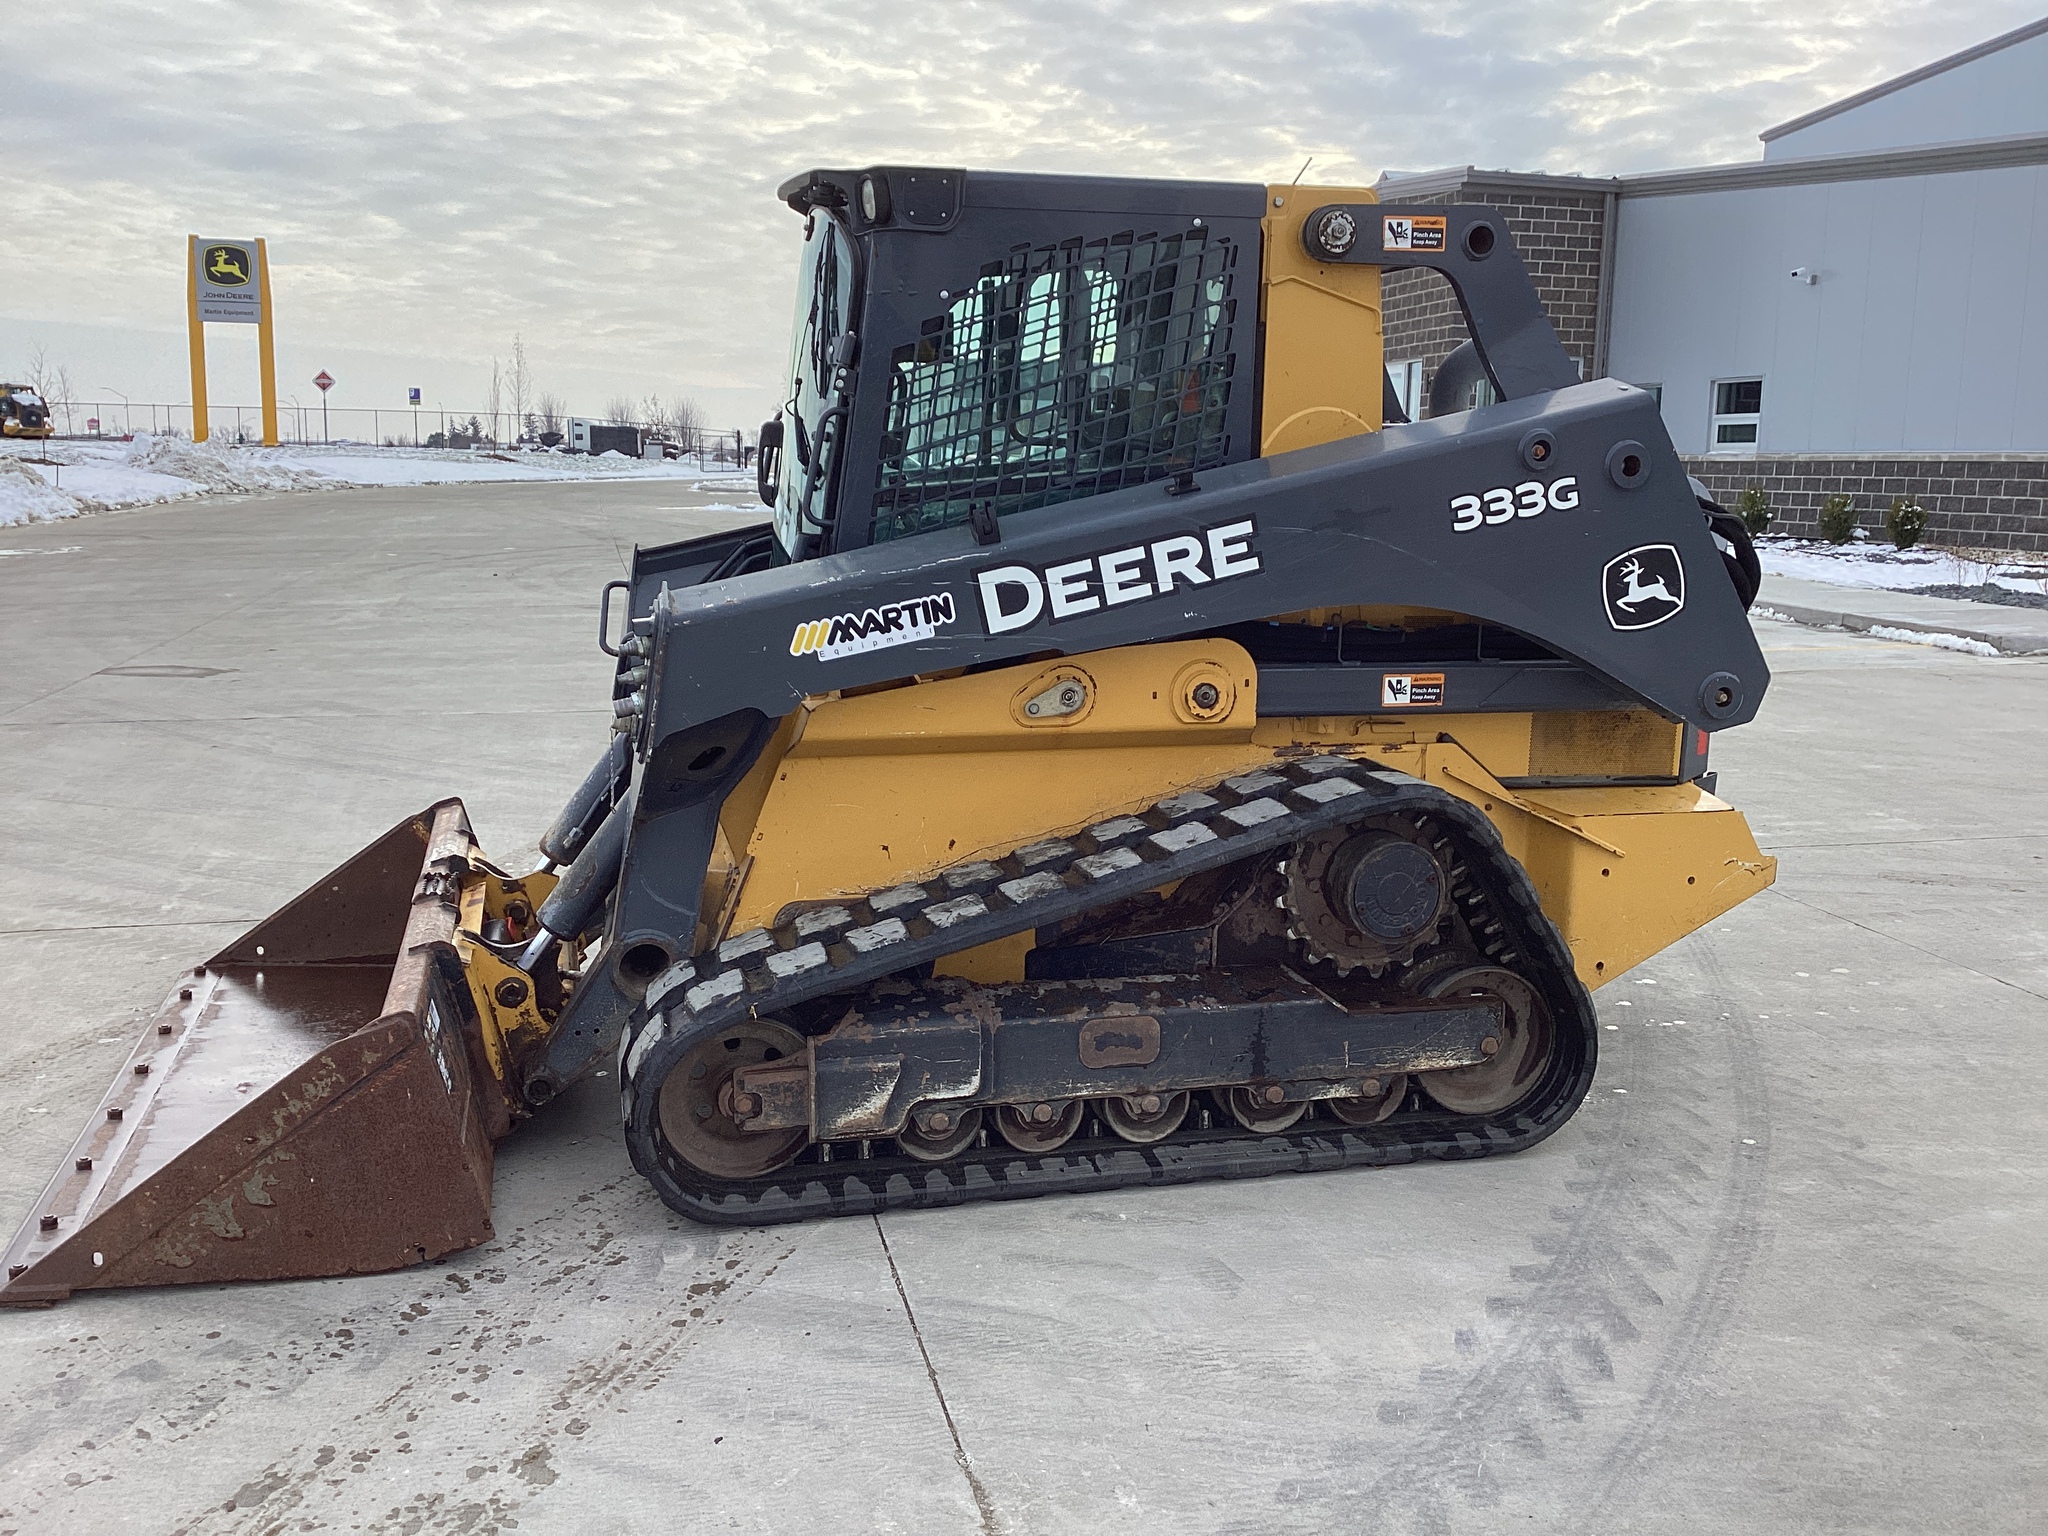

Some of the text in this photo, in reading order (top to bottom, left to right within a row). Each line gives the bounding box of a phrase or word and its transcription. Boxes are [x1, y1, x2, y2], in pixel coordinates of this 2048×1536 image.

[203, 291, 254, 300] JOHN DEERE
[223, 308, 255, 316] Equipment
[1450, 476, 1579, 532] 333G
[977, 520, 1260, 635] DEERE
[827, 595, 953, 646] MARTIN
[819, 627, 934, 658] Equipment
